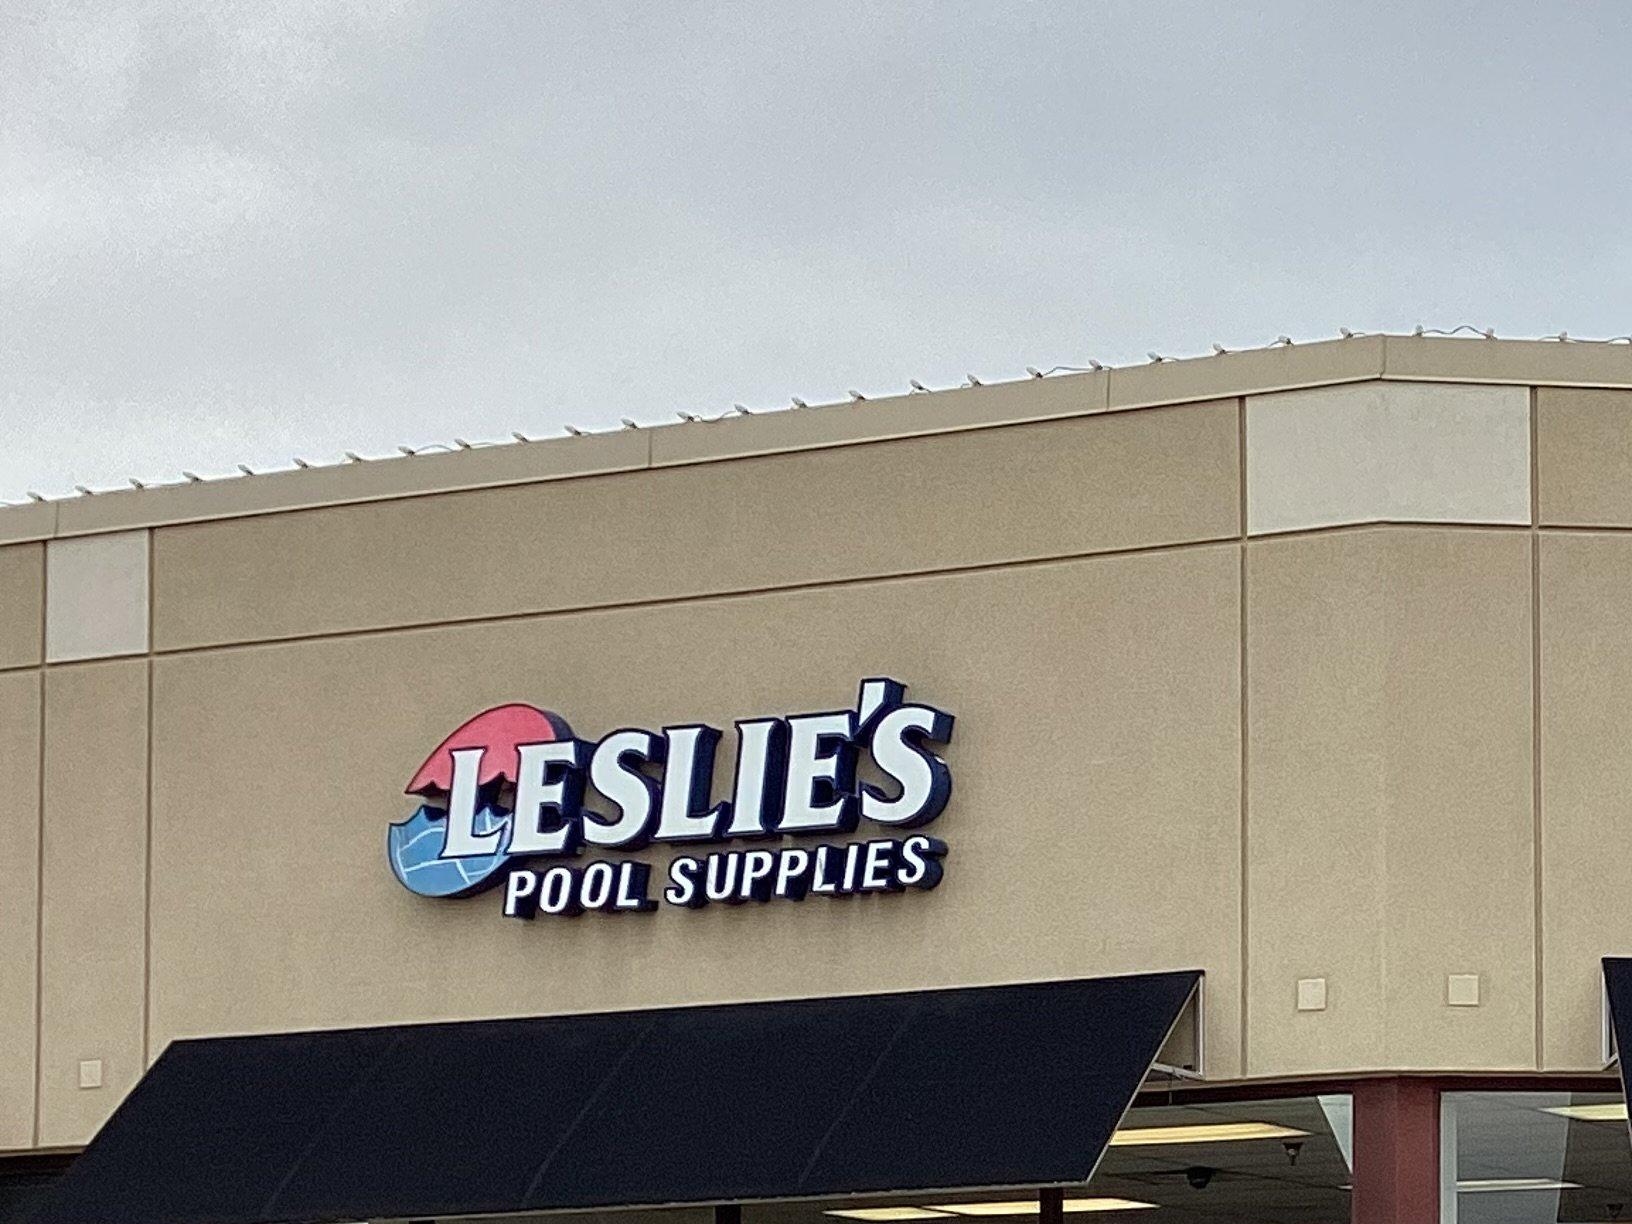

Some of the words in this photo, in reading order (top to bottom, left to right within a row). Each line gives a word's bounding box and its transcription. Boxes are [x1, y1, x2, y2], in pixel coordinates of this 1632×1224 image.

[440, 677, 953, 860] LESLIE'S
[504, 860, 648, 918] POOL
[664, 835, 942, 907] SUPPLIES
